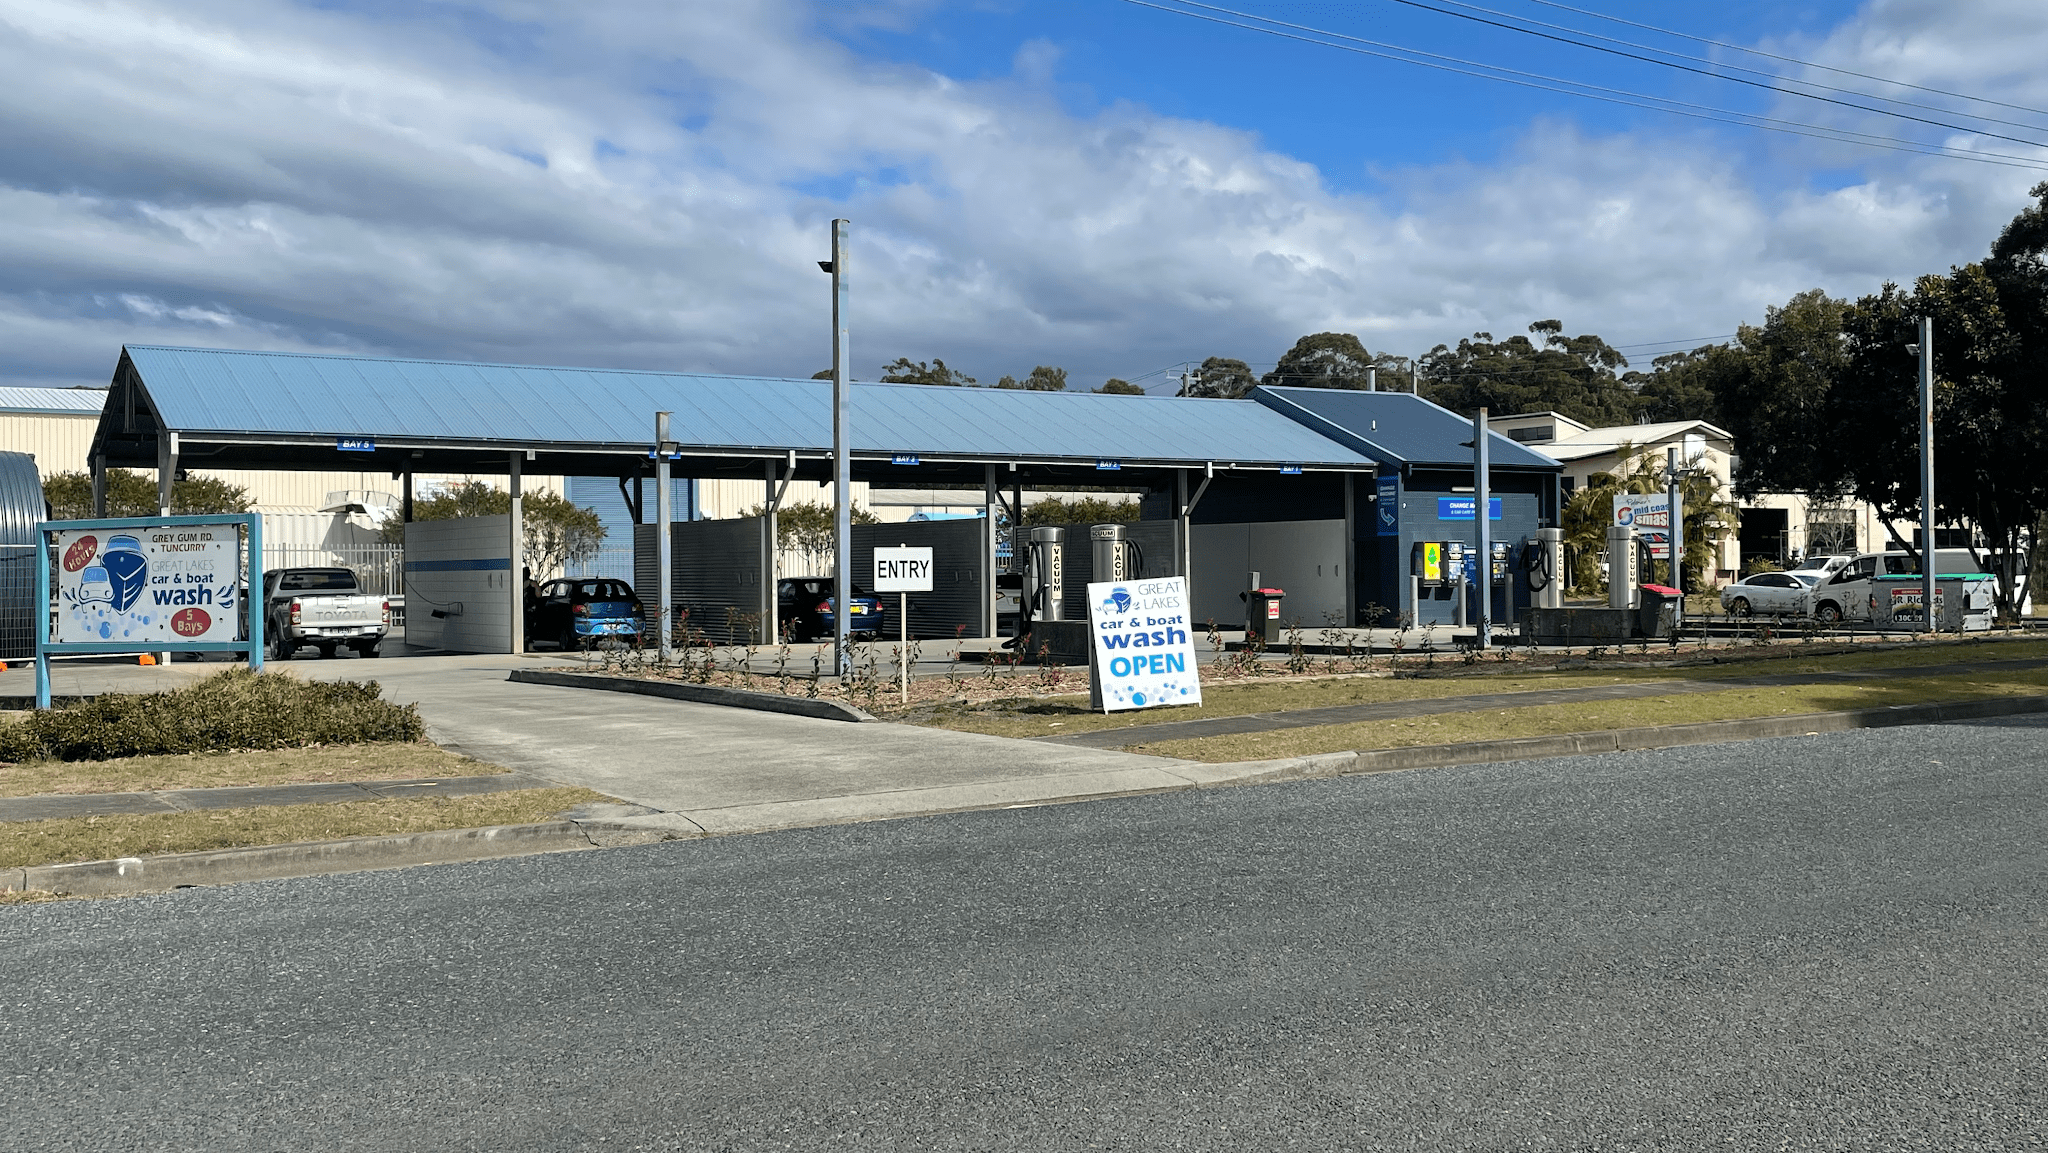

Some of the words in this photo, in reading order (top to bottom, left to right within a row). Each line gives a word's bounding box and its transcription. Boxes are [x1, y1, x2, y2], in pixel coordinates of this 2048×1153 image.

[343, 440, 362, 448] BAY
[364, 440, 370, 448] 5
[1634, 506, 1648, 514] mid
[1651, 504, 1670, 512] coas
[1635, 513, 1669, 526] smas
[152, 534, 174, 542] GREY
[178, 533, 197, 541] GUM
[200, 533, 214, 541] RD.
[71, 541, 84, 556] 24
[160, 543, 206, 552] TUNCURRY
[152, 560, 184, 572] GREAT
[186, 559, 214, 571] LAKES
[878, 560, 929, 578] ENTRY
[1053, 548, 1061, 592] VACUUM
[152, 574, 169, 584] car
[173, 573, 182, 583] &
[187, 573, 214, 583] boat
[153, 584, 212, 605] wash
[1138, 581, 1180, 595] GREAT
[1144, 597, 1180, 610] LAKES
[186, 609, 193, 620] 5
[316, 611, 368, 620] TOYOTA
[177, 620, 203, 634] Bays
[1100, 620, 1123, 629] car
[1129, 617, 1141, 627] &
[1146, 615, 1183, 626] boat
[1101, 626, 1186, 650] wash
[1110, 652, 1185, 677] OPEN
